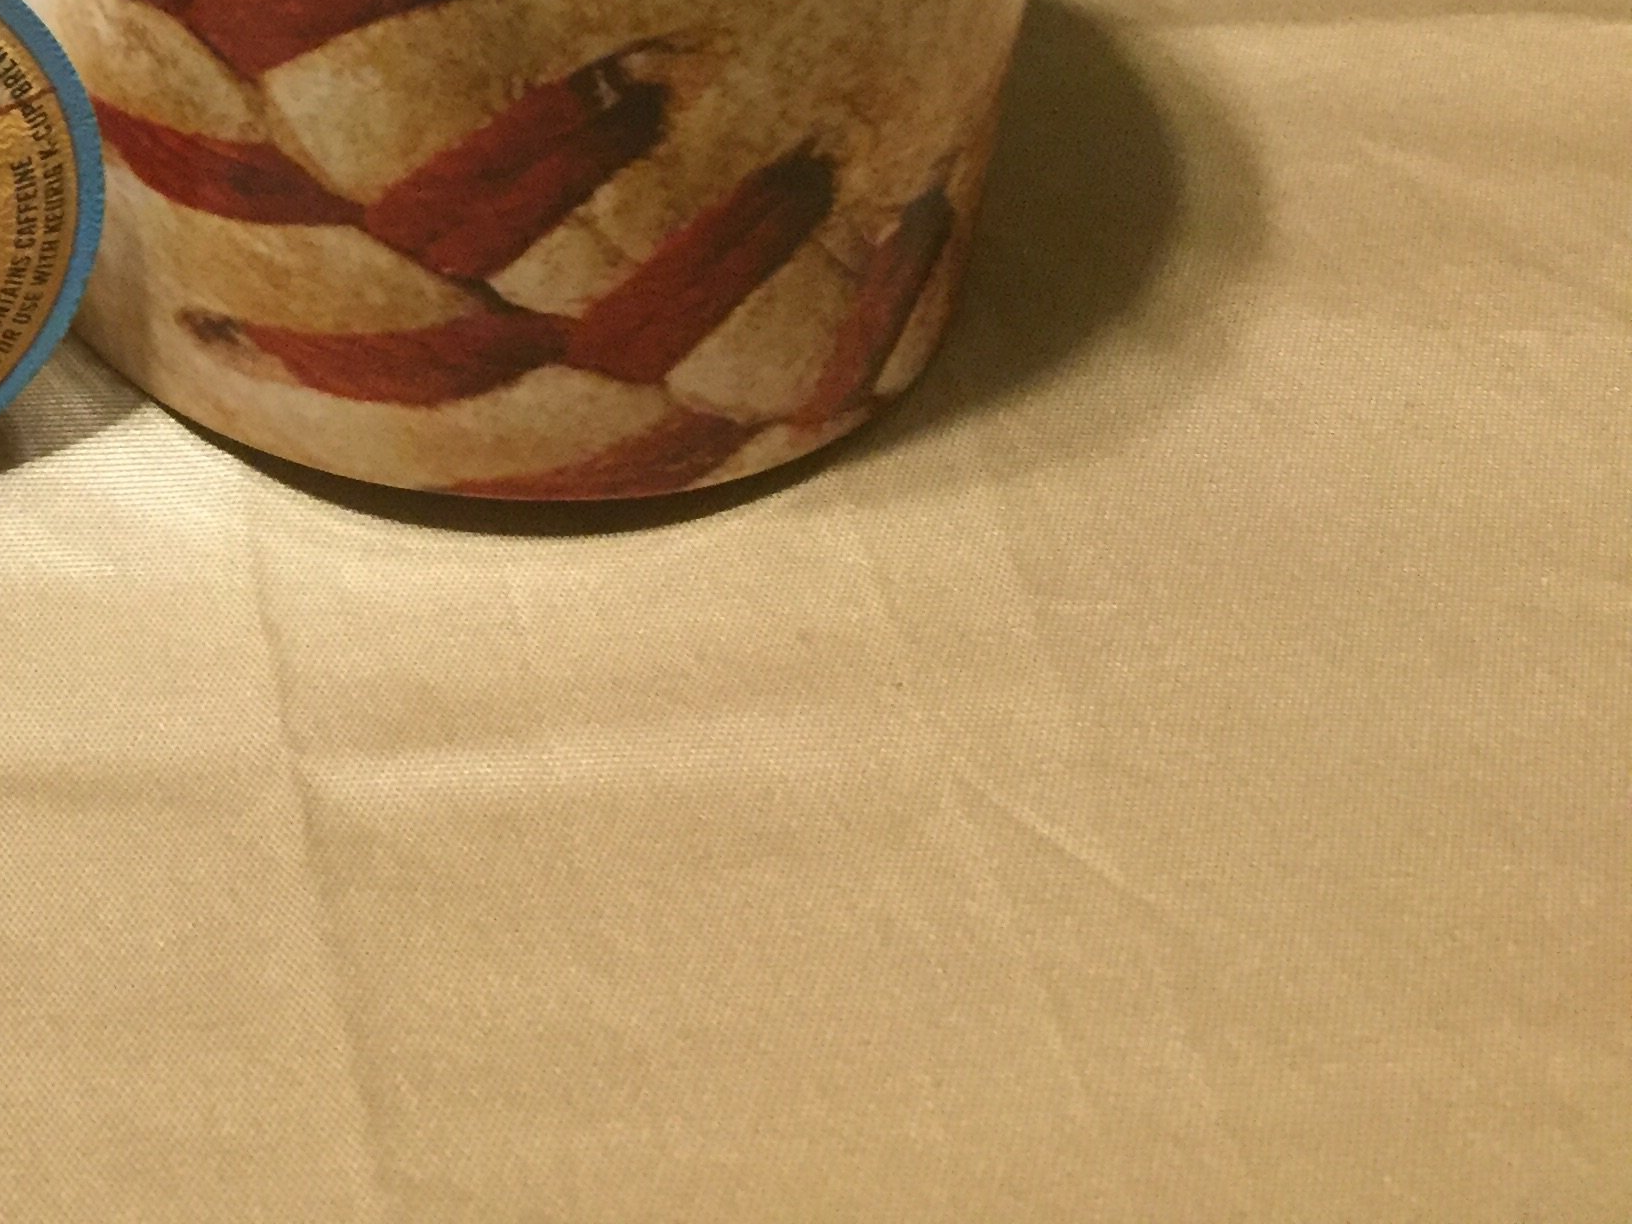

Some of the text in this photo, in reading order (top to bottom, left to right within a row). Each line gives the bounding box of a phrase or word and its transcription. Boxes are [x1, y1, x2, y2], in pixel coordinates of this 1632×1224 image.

[10, 155, 38, 250] CAFFEINE
[12, 290, 43, 326] USE
[30, 239, 60, 287] WITH
